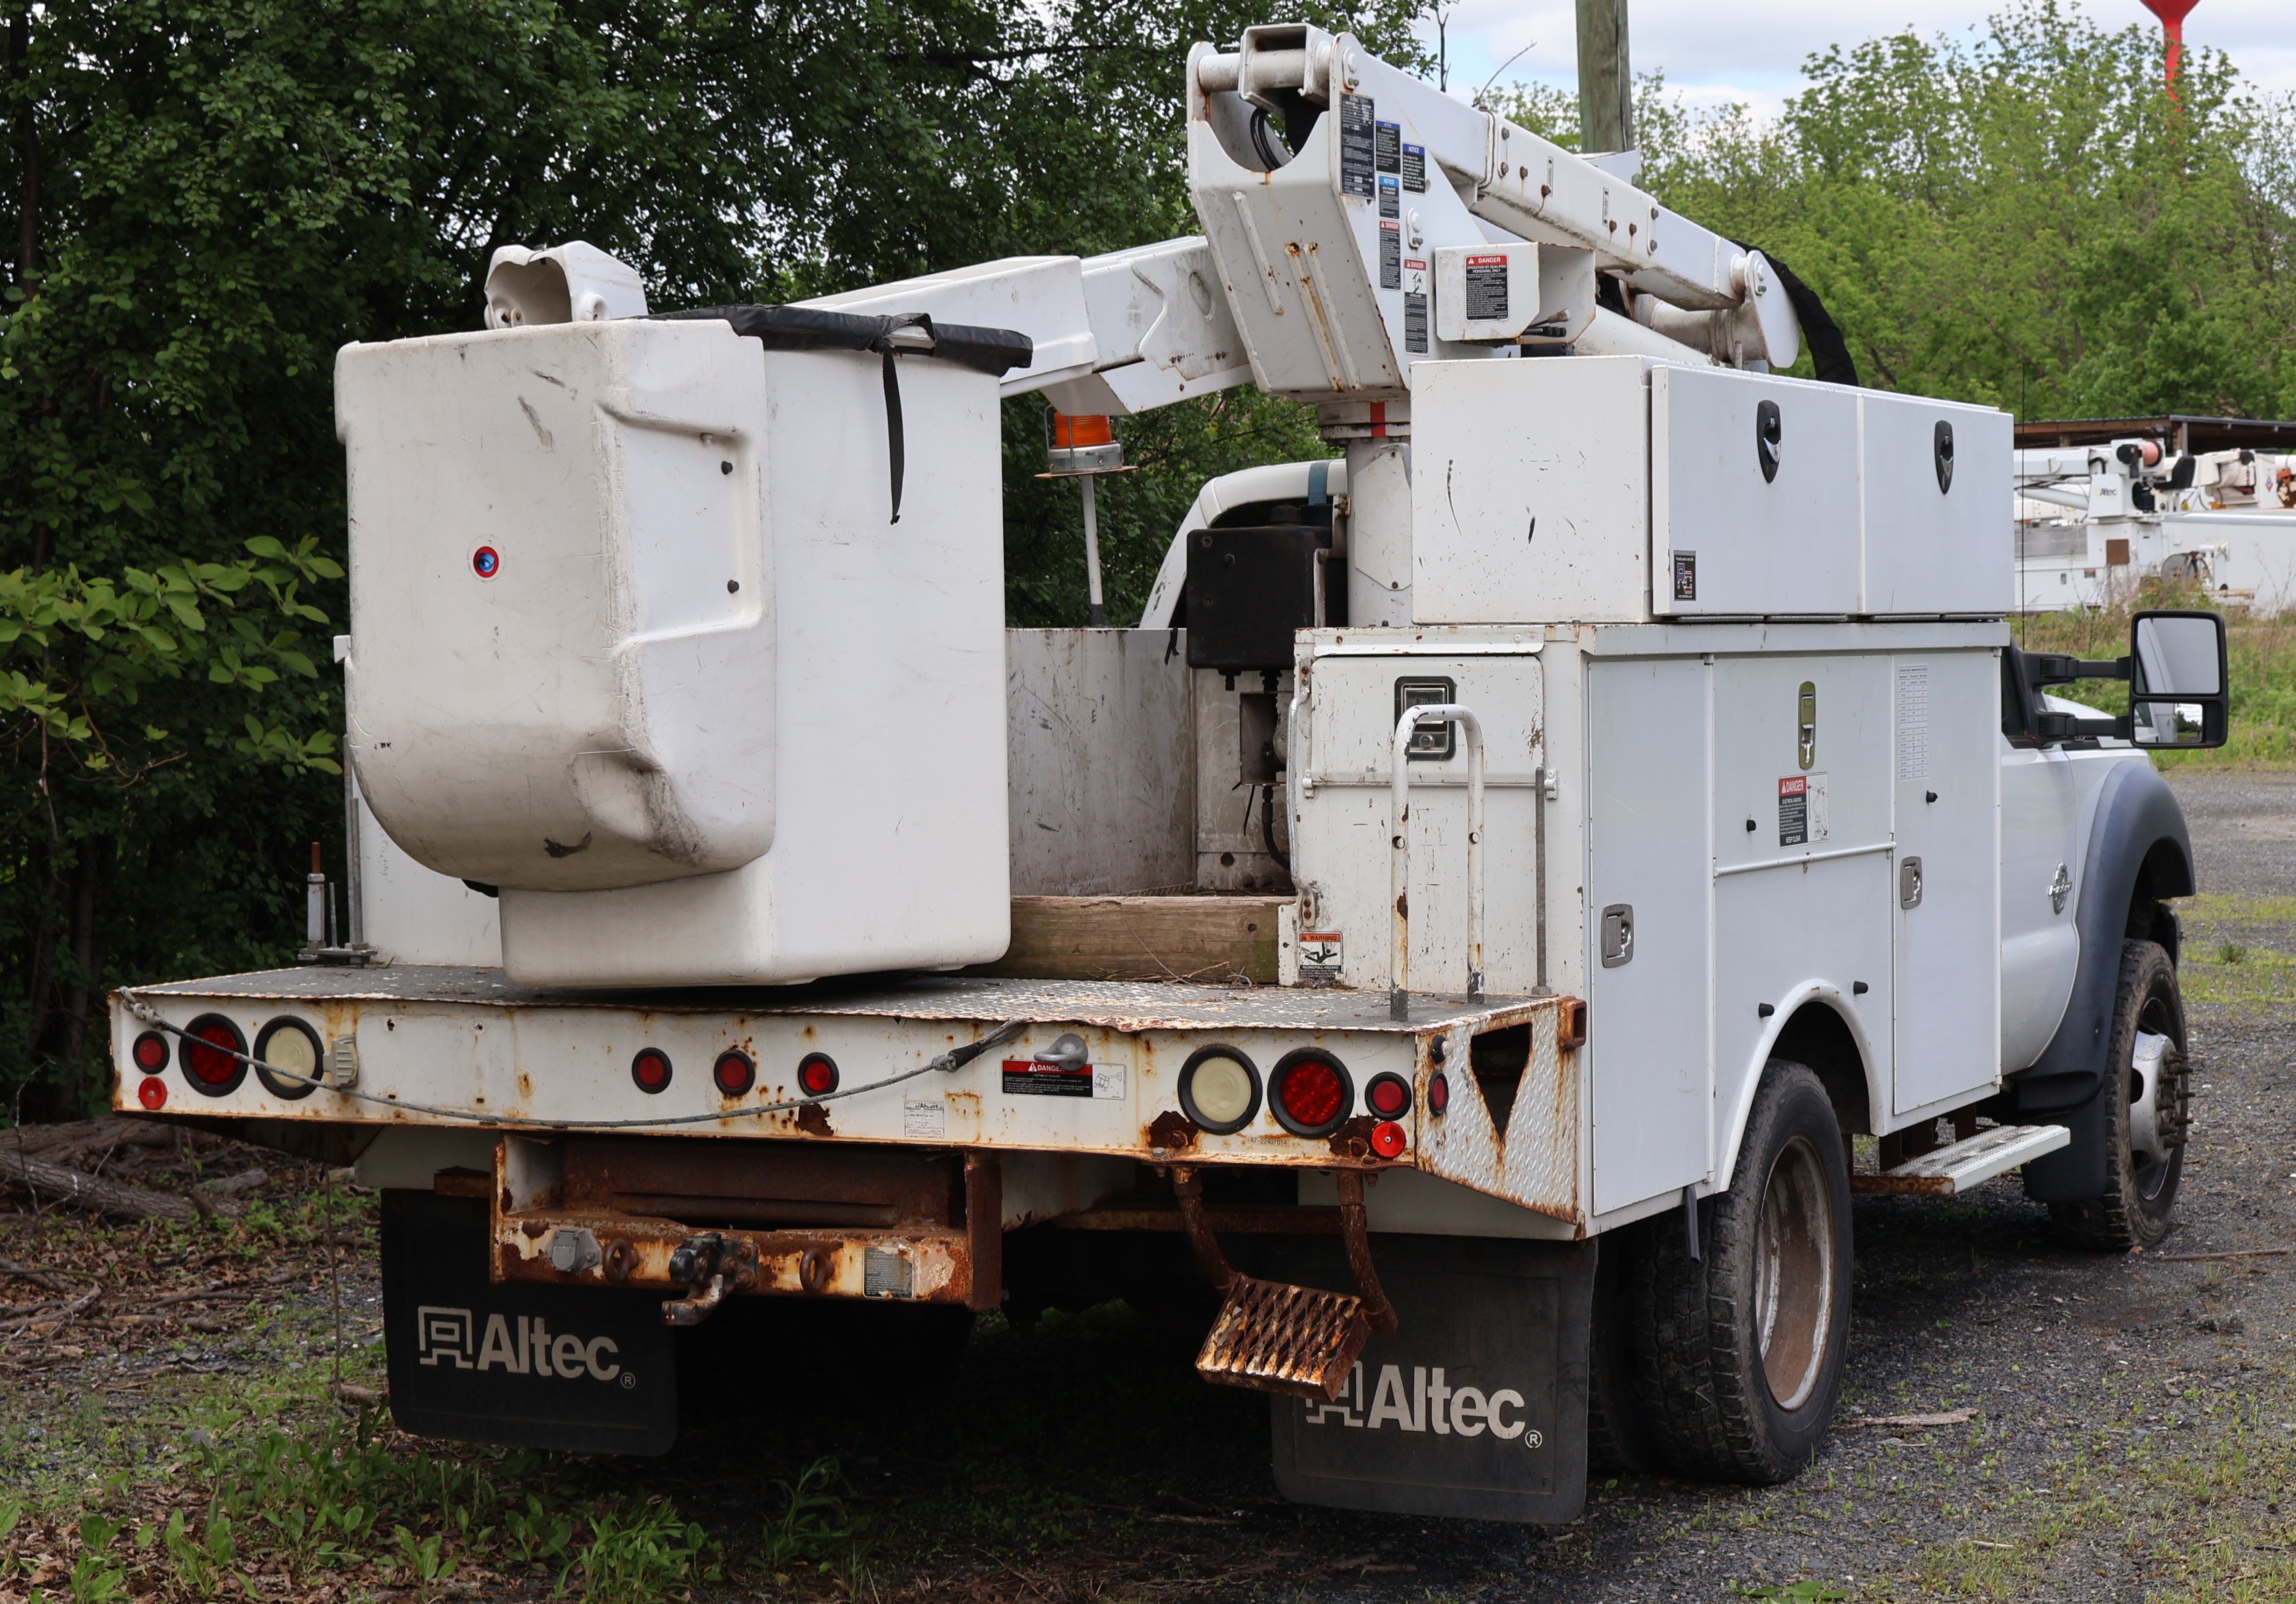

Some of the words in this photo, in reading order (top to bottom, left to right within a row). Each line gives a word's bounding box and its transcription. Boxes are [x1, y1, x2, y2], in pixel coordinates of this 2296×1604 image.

[1786, 779, 1804, 792] DANGER
[477, 1313, 620, 1381] Altec
[1367, 1364, 1526, 1440] Altec
